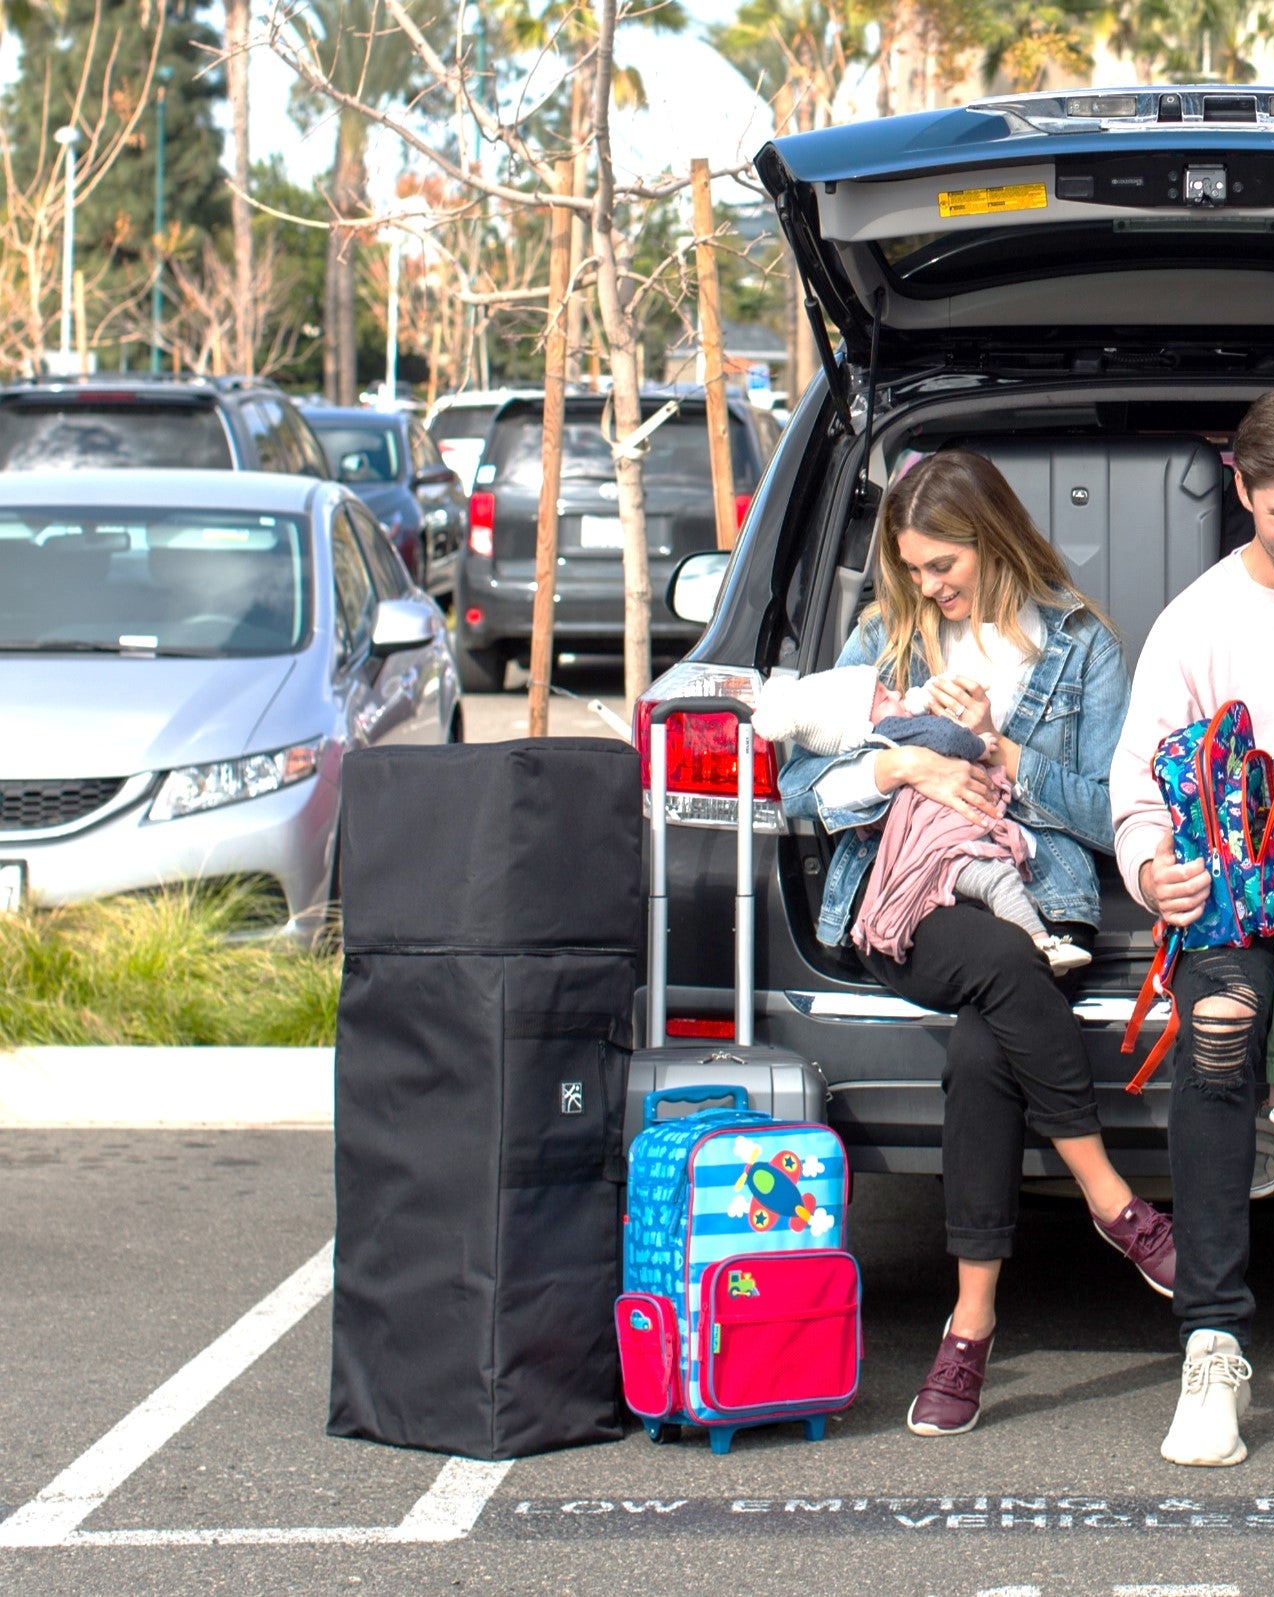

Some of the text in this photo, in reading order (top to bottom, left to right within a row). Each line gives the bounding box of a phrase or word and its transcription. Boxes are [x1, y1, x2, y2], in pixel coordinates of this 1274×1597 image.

[514, 1500, 689, 1514] LOW
[731, 1498, 1108, 1512] EMITTING
[1158, 1499, 1204, 1511] &
